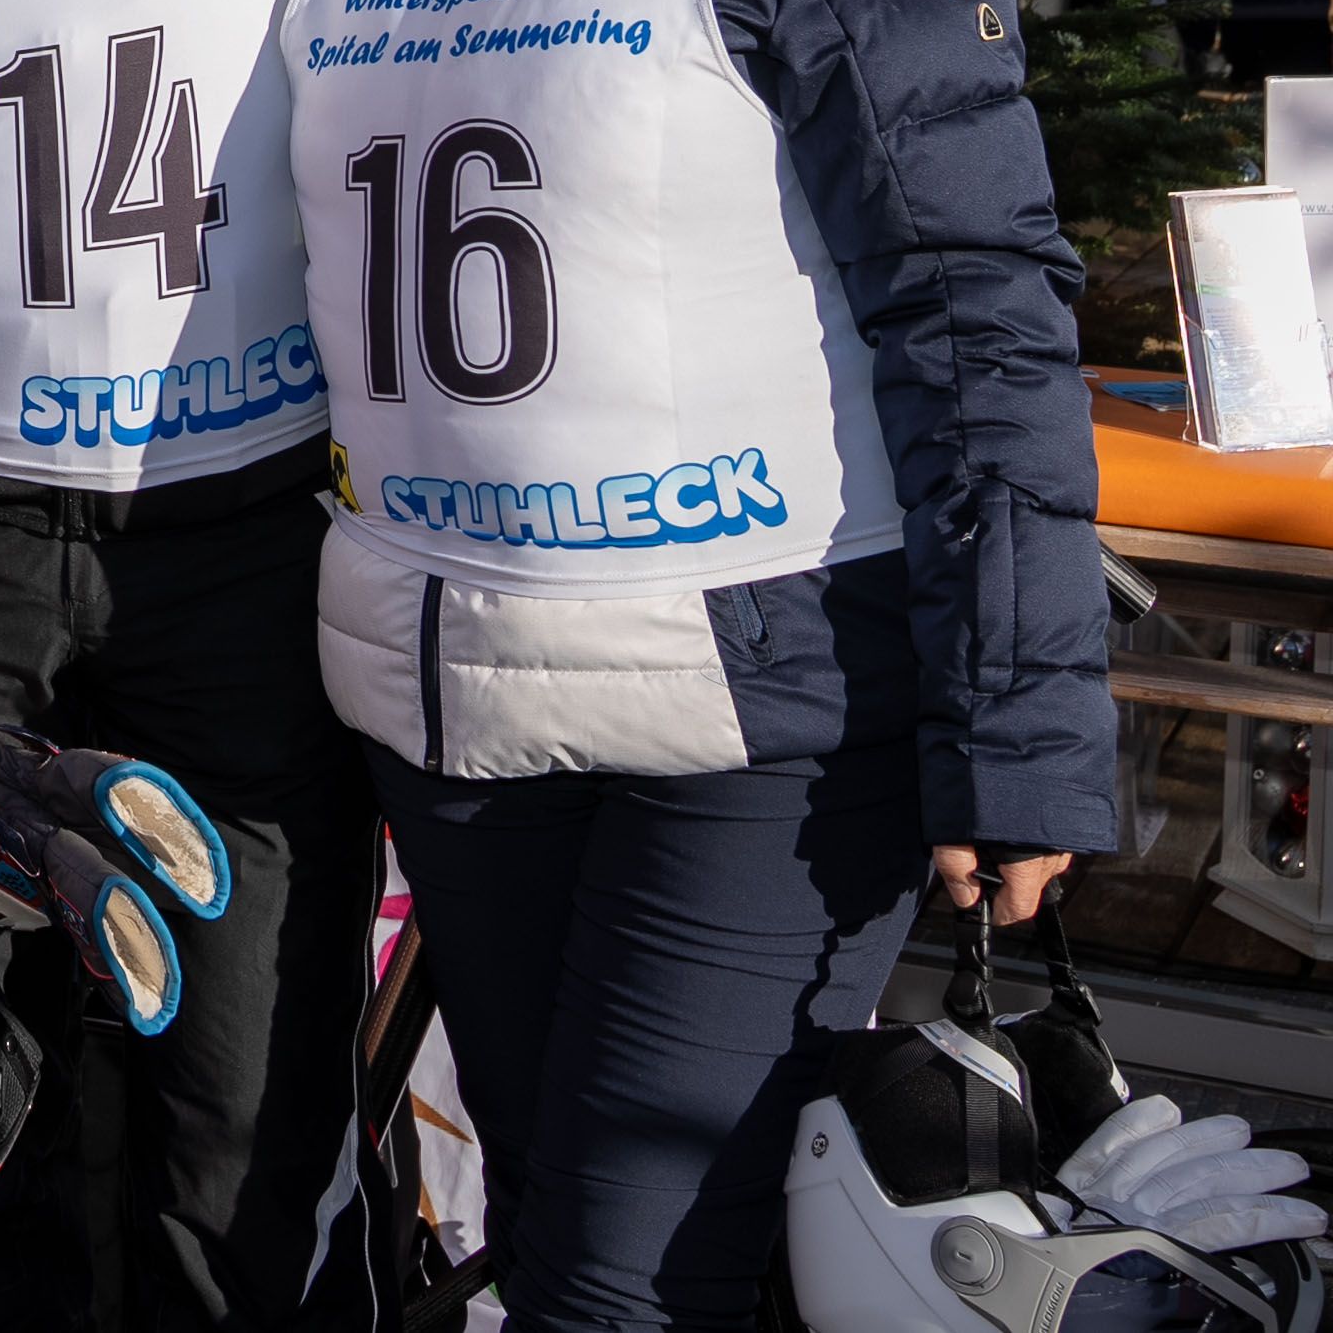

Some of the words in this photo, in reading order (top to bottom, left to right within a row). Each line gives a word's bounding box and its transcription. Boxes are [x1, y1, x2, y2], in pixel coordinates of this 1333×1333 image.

[306, 31, 387, 75] Spital
[393, 37, 442, 65] am
[448, 8, 653, 58] Semmering
[345, 118, 559, 407] 16
[18, 319, 330, 449] STUHLEC
[381, 448, 788, 550] STUHLECK
